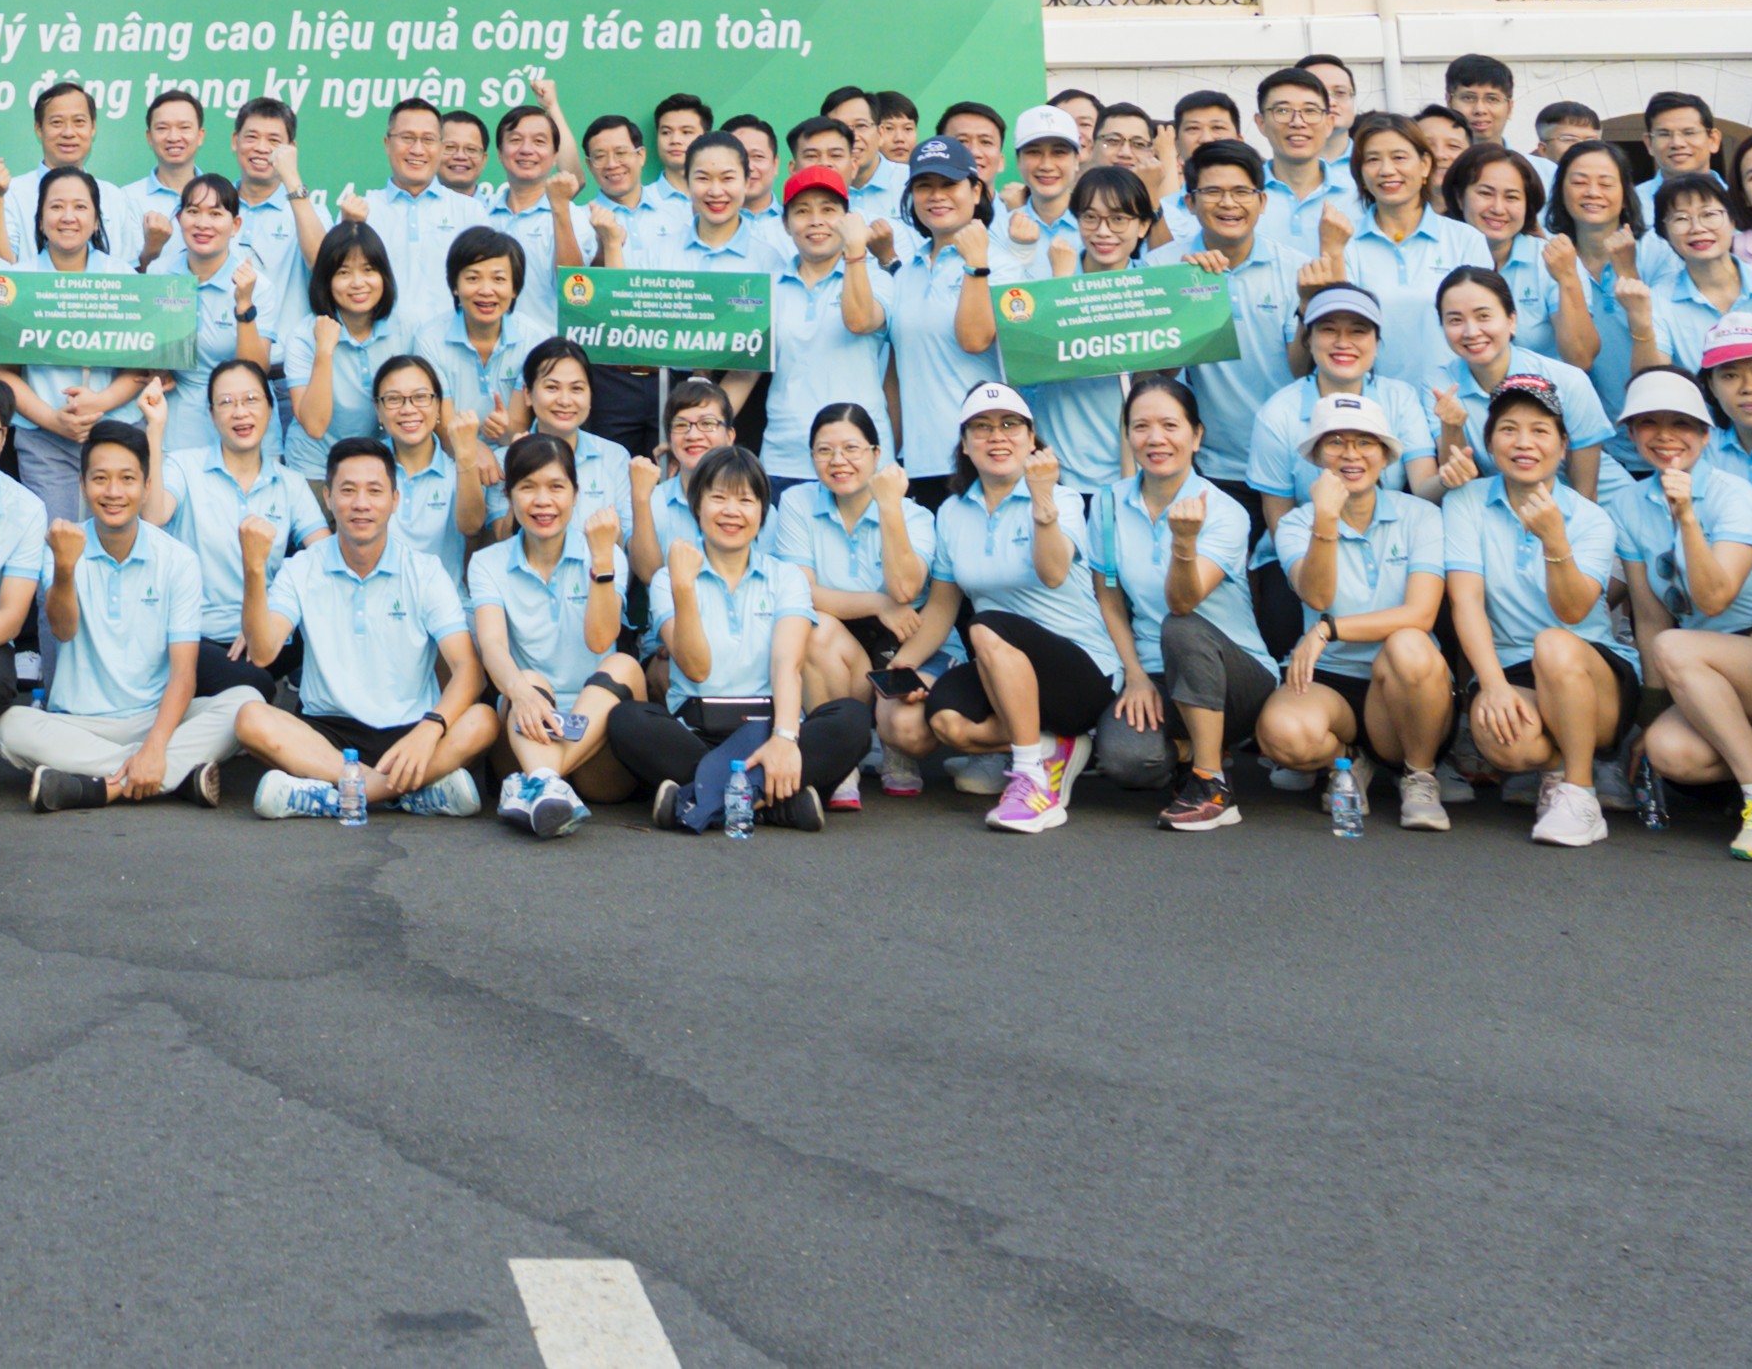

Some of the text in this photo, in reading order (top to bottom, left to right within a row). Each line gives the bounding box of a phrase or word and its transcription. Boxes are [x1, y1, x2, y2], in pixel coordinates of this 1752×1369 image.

[37, 12, 82, 54] và
[92, 11, 193, 62] nâng
[205, 21, 276, 52] cao
[288, 10, 375, 60] hiệu
[386, 7, 458, 60] quả
[472, 10, 569, 60] công
[582, 9, 643, 51] tác
[654, 20, 702, 50] an
[715, 9, 812, 57] toàn,
[28, 69, 132, 120] đng
[18, 328, 156, 351] PV COATING
[565, 323, 763, 357] KHÍ ĐÔNG NAM BỘ
[1057, 327, 1182, 362] LOGISTICS
